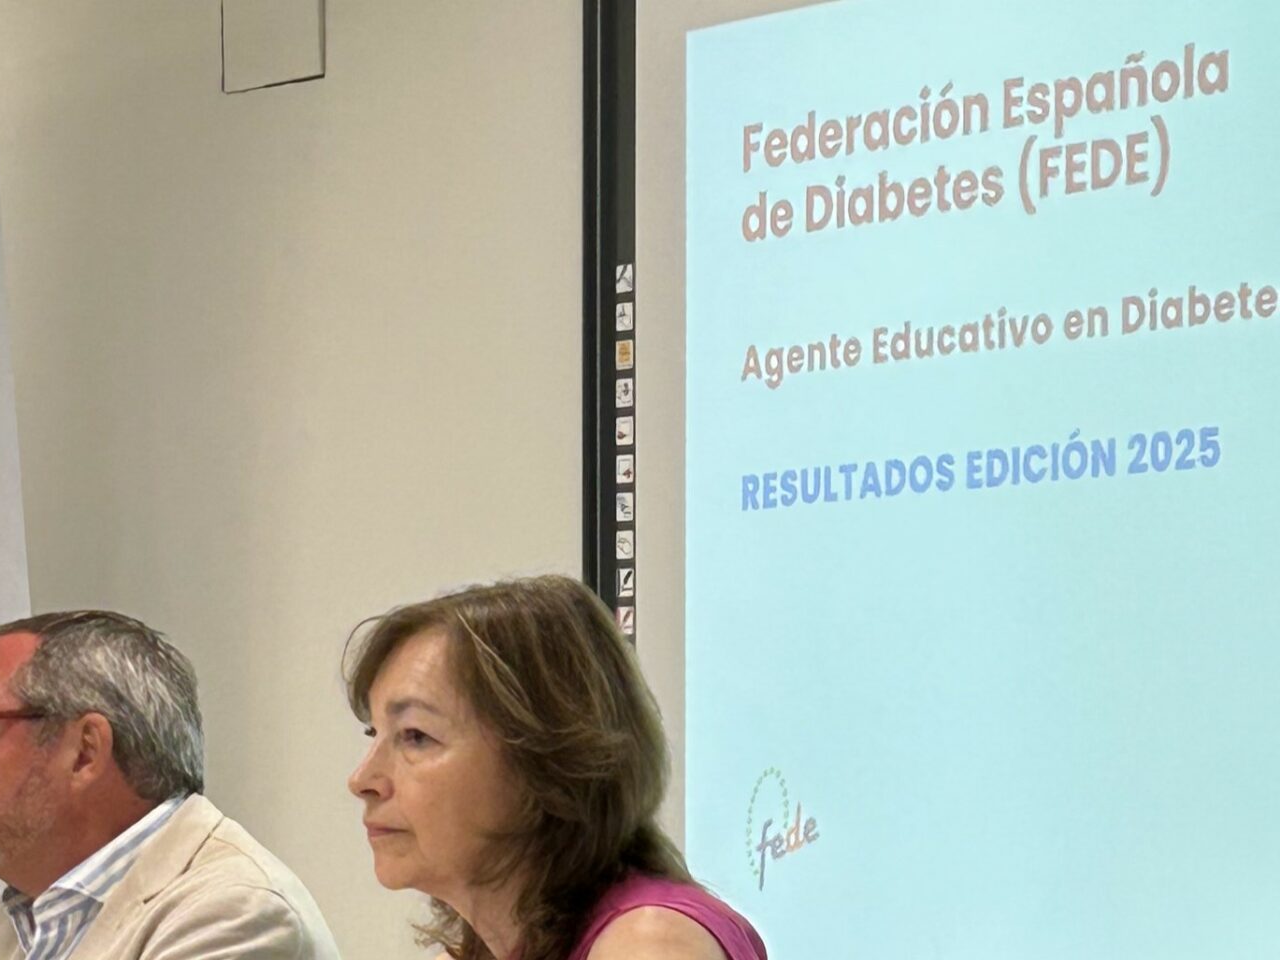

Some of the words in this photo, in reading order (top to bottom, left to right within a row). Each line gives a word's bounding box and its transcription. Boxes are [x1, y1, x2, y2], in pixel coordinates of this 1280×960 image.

[742, 80, 989, 174] Federación
[1002, 42, 1229, 139] Española
[741, 191, 794, 242] de
[805, 165, 1004, 232] Diabetes
[1018, 114, 1170, 215] (FEDE)
[741, 333, 862, 390] Agente
[872, 305, 1054, 364] Educativo
[1063, 306, 1109, 340] en
[1121, 282, 1278, 336] Diabete
[741, 453, 955, 511] RESULTADOS
[966, 428, 1116, 489] EDICIÓN
[1127, 426, 1221, 474] 2025
[756, 800, 820, 891] fede
